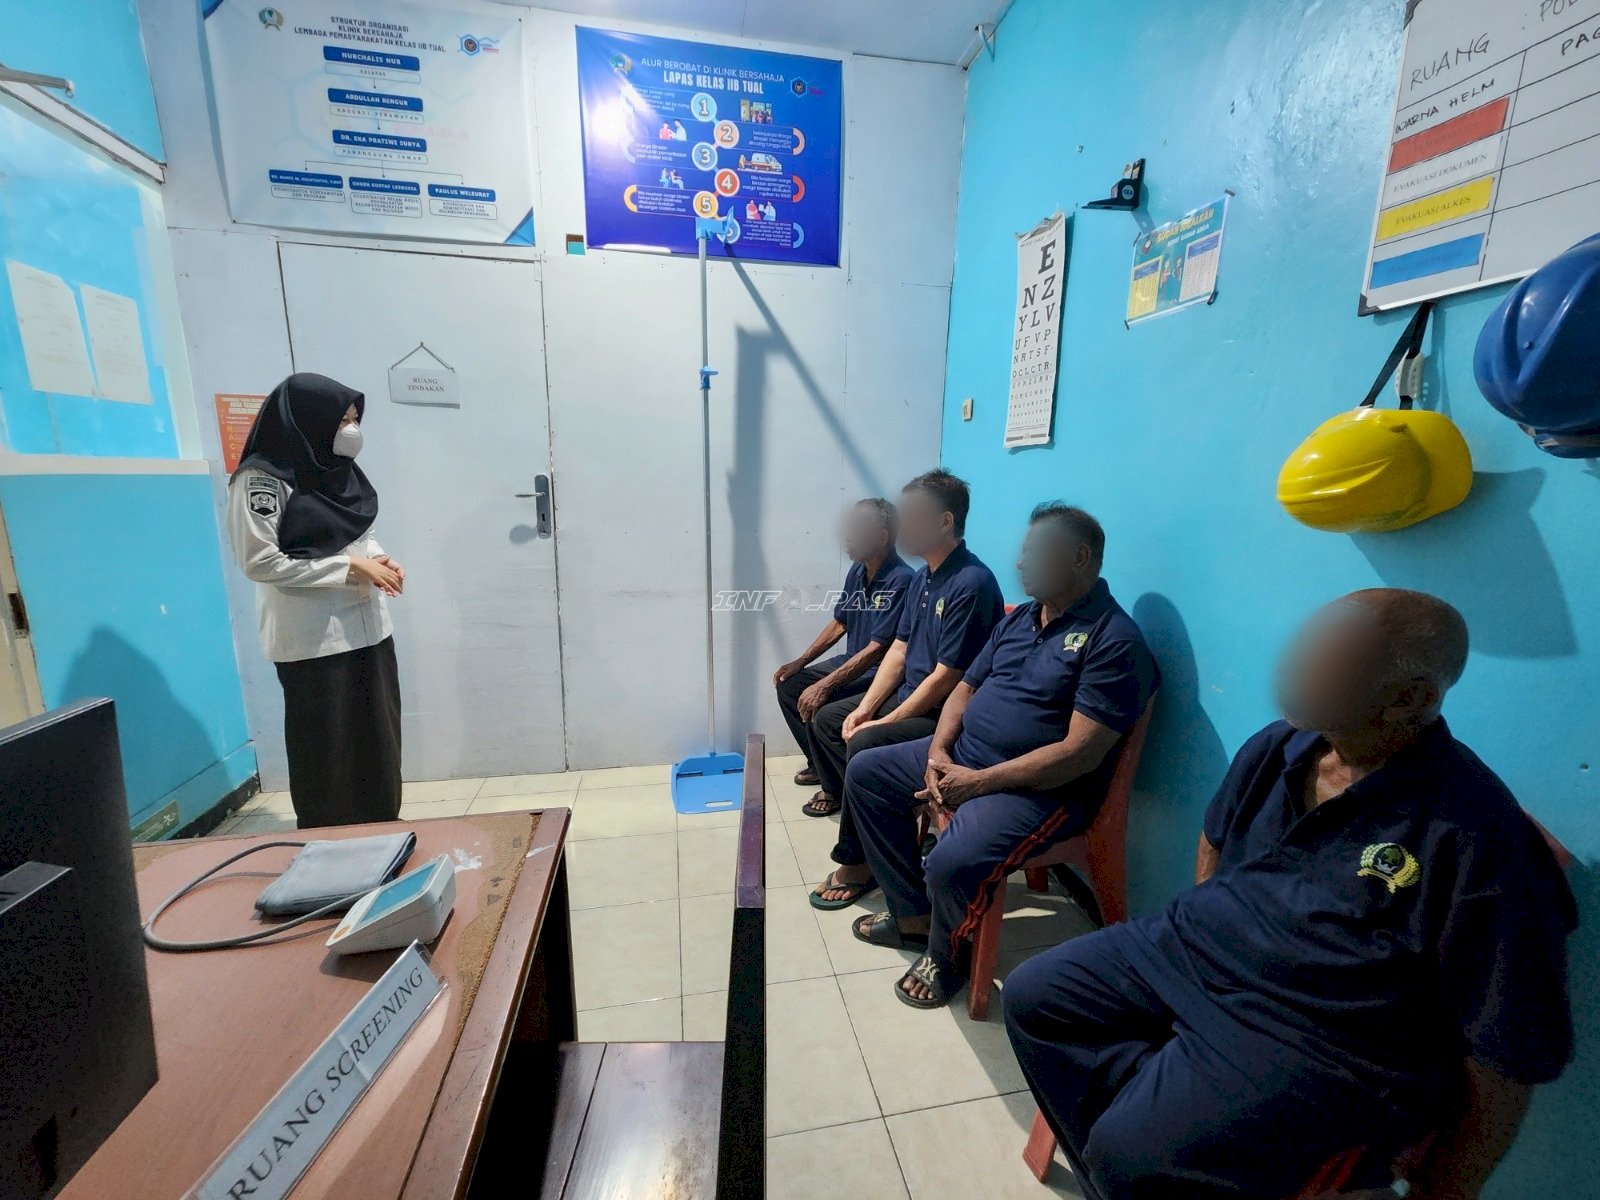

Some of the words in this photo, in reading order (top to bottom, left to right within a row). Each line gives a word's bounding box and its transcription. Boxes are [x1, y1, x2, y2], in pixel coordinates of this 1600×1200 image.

[330, 16, 367, 27] STRUKTUR
[368, 21, 409, 32] ORGANISASI
[338, 25, 361, 34] KLINIK
[362, 28, 404, 39] BERSAHAJA
[294, 27, 327, 37] LEMBAGA
[329, 31, 394, 45] PEMASYARAKATAN
[395, 40, 416, 49] KELAS
[418, 42, 427, 50] IIB
[429, 44, 446, 52] TUAL
[641, 57, 662, 68] ALUR
[663, 60, 701, 73] BEROBAT
[703, 66, 712, 74] DI
[713, 67, 738, 78] KLINIK
[738, 70, 785, 83] BERSAHAJA
[1410, 32, 1490, 92] RUANG
[663, 70, 694, 87] LAPAS
[696, 74, 725, 90] KELAS
[727, 78, 740, 92] IIB
[742, 80, 765, 95] TUAL
[345, 93, 380, 103] ABDULLAH
[700, 99, 709, 115] 1
[1395, 105, 1439, 134] WARNA
[721, 126, 733, 142] 2
[700, 148, 711, 164] 3
[1393, 171, 1436, 193] EVAKUASI
[1438, 152, 1488, 177] DOKUMEN
[721, 174, 733, 190] 4
[701, 197, 711, 212] 5
[1395, 204, 1438, 225] EVAKUASI
[1038, 238, 1056, 275] E
[407, 385, 445, 393] TINDAKAN
[412, 377, 438, 385] RUANG
[227, 1089, 326, 1200] RUANG
[325, 966, 424, 1093] SCREENING
